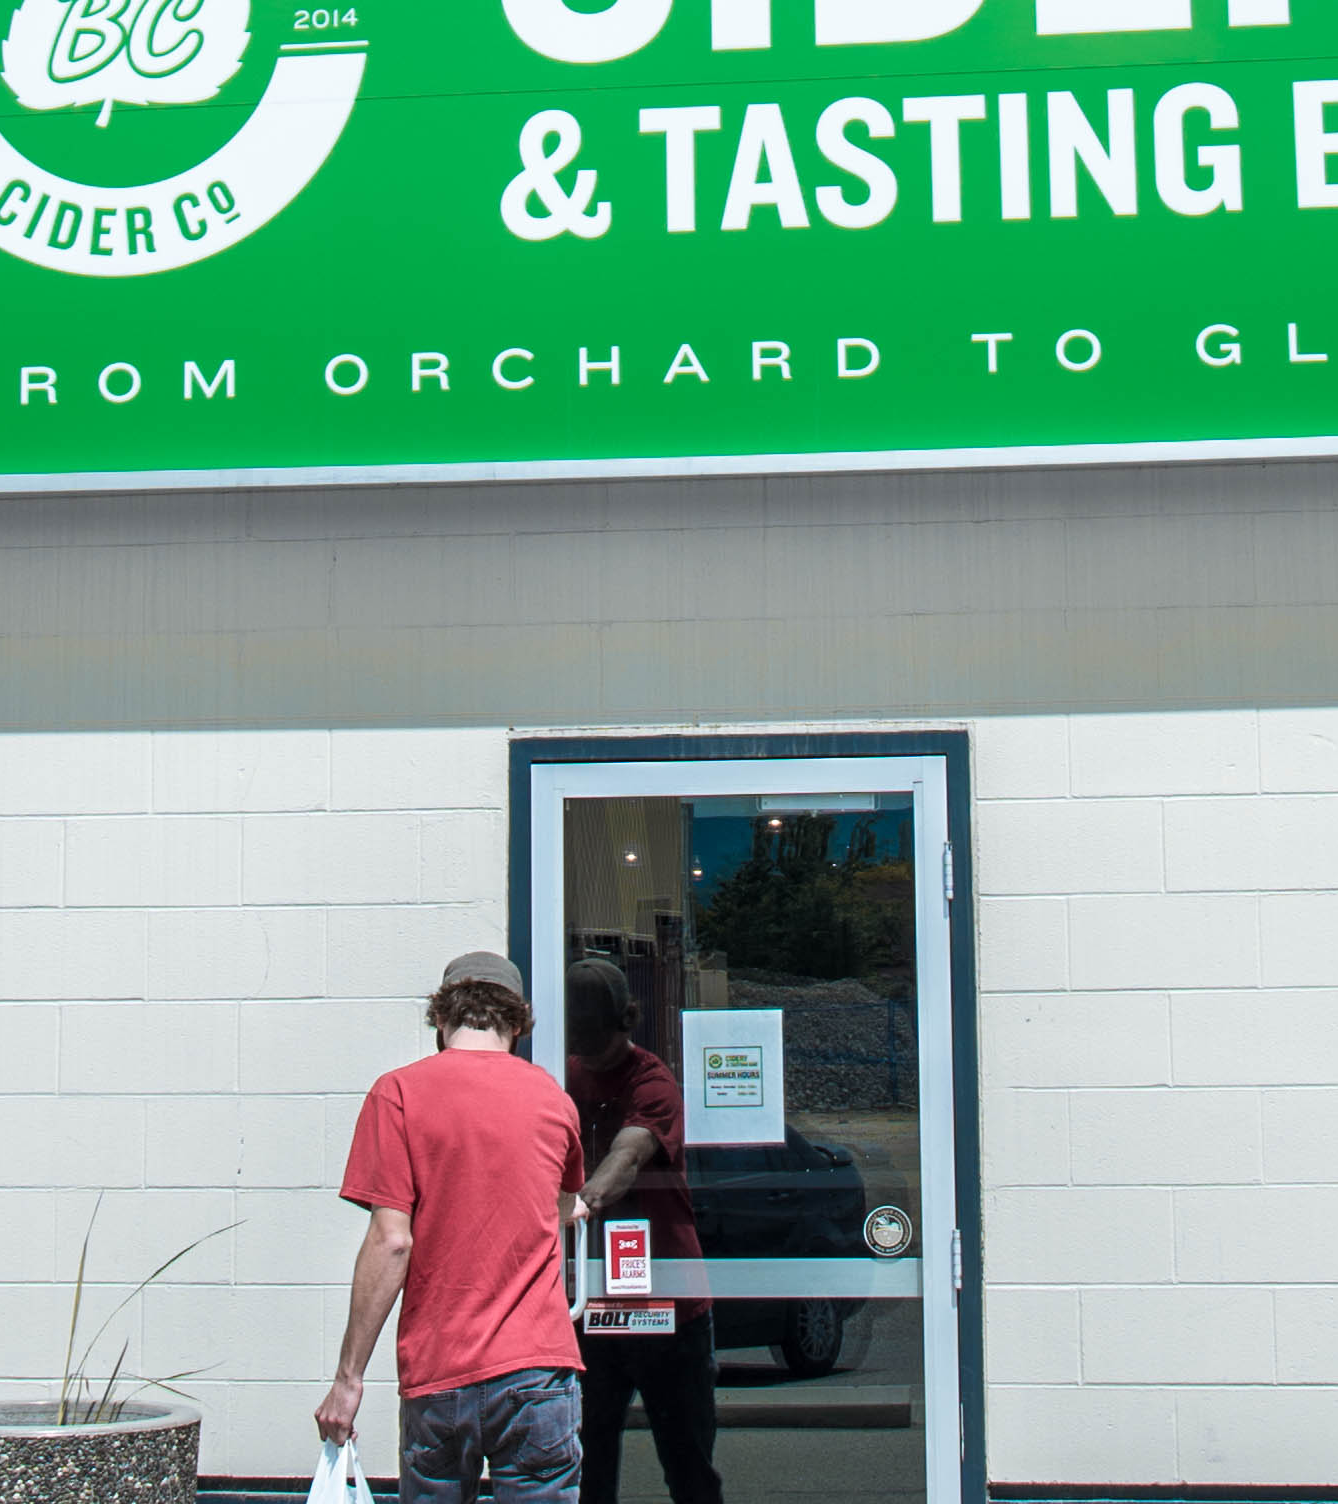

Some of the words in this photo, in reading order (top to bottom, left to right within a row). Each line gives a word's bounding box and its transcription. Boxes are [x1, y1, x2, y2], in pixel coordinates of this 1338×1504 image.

[292, 7, 359, 30] 2014
[499, 107, 612, 242] &
[638, 81, 1244, 236] TASTING
[323, 336, 882, 398] ORCHARD
[970, 327, 1103, 374] TO
[621, 1269, 646, 1279] ALARMS
[588, 1311, 632, 1327] BOLT
[633, 1310, 670, 1318] SECURITY
[631, 1318, 670, 1327] SYSTEMS
